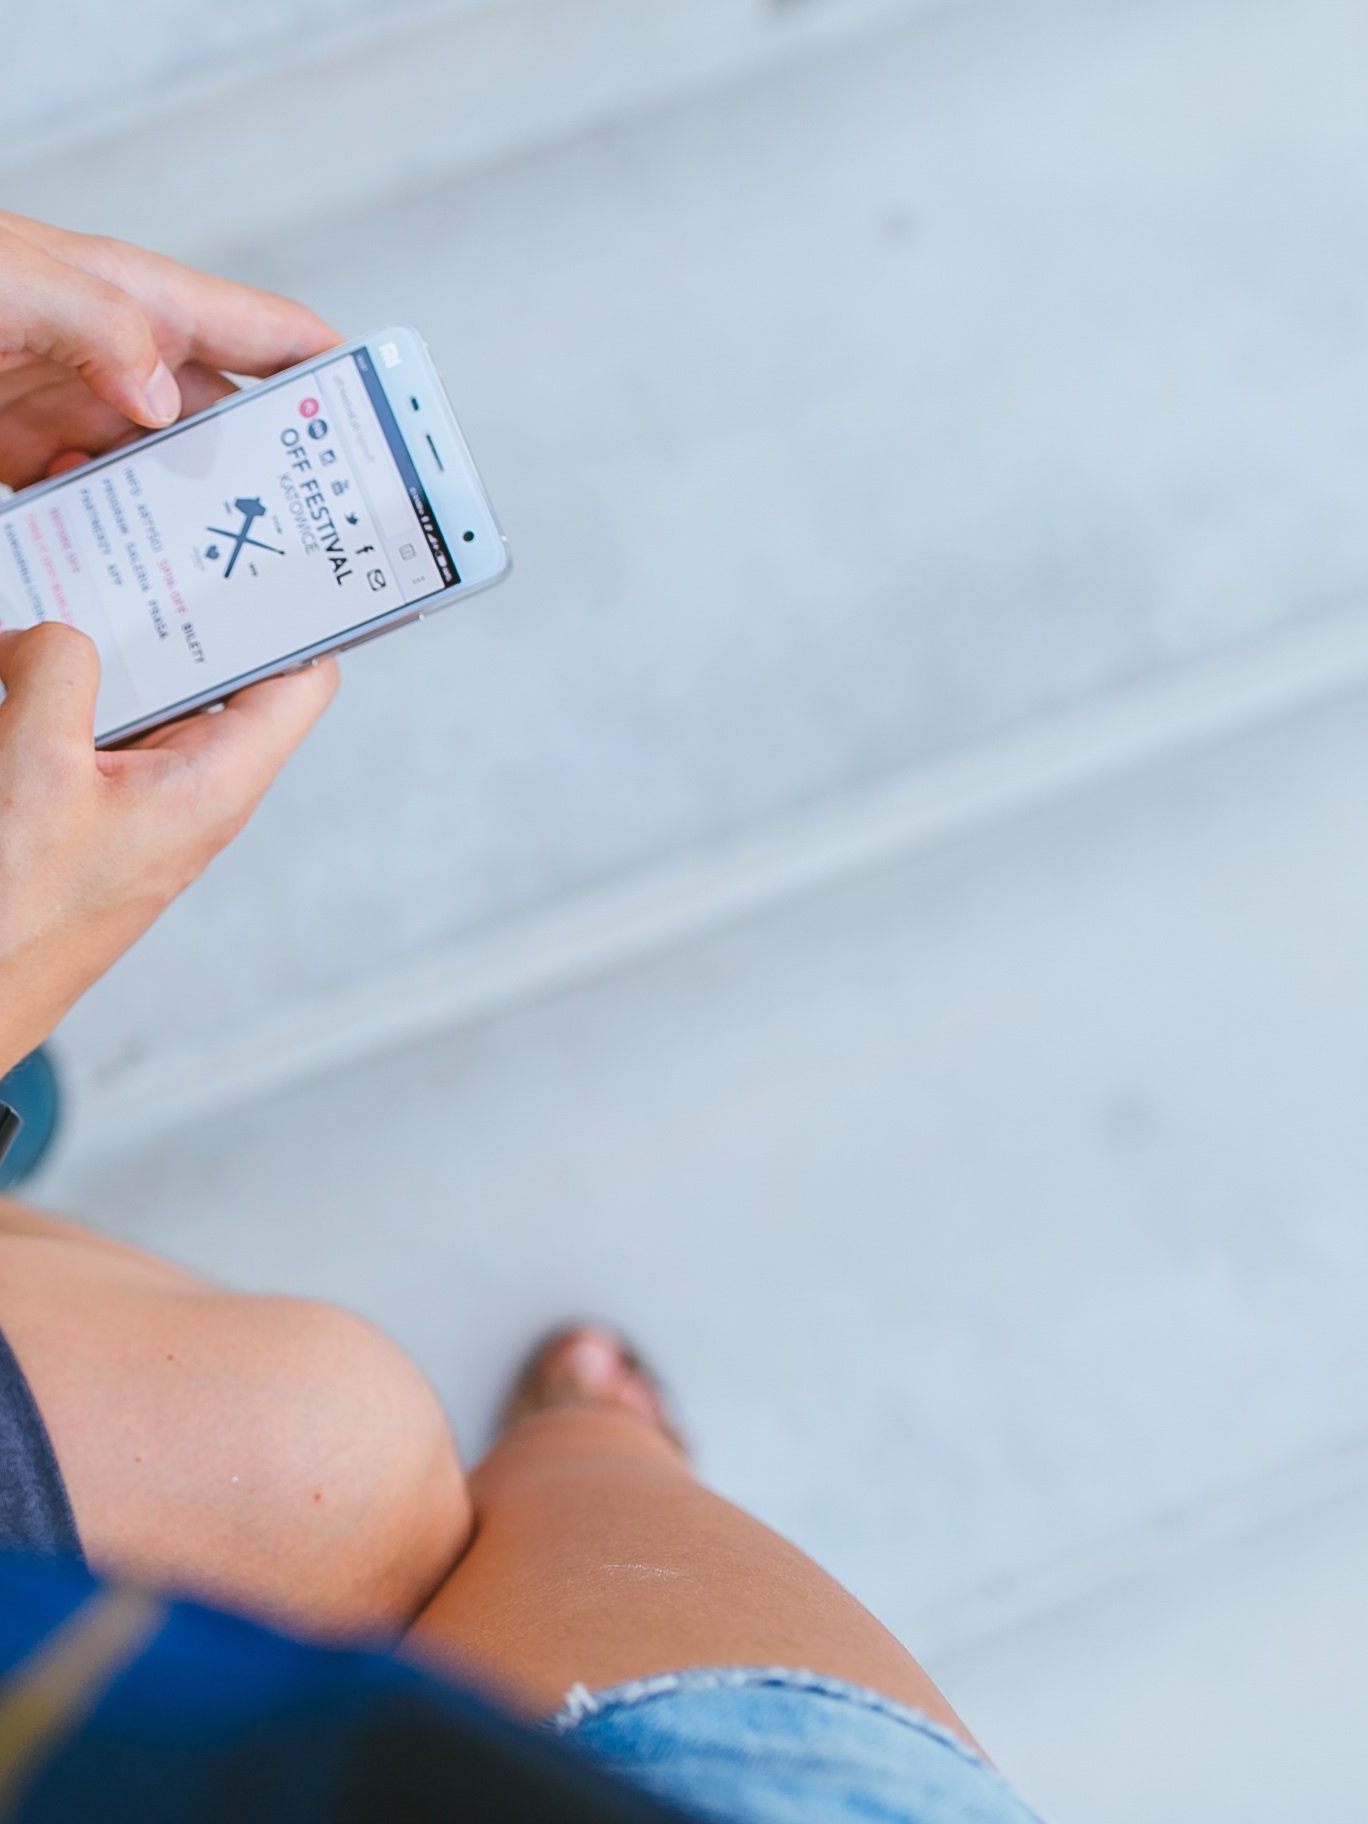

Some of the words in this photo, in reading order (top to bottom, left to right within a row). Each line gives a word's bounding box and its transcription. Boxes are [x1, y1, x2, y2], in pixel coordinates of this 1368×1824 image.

[278, 474, 319, 554] KATOWICE
[280, 427, 310, 473] OFF
[300, 478, 354, 585] FESTIVAL
[182, 622, 206, 664] BILETY
